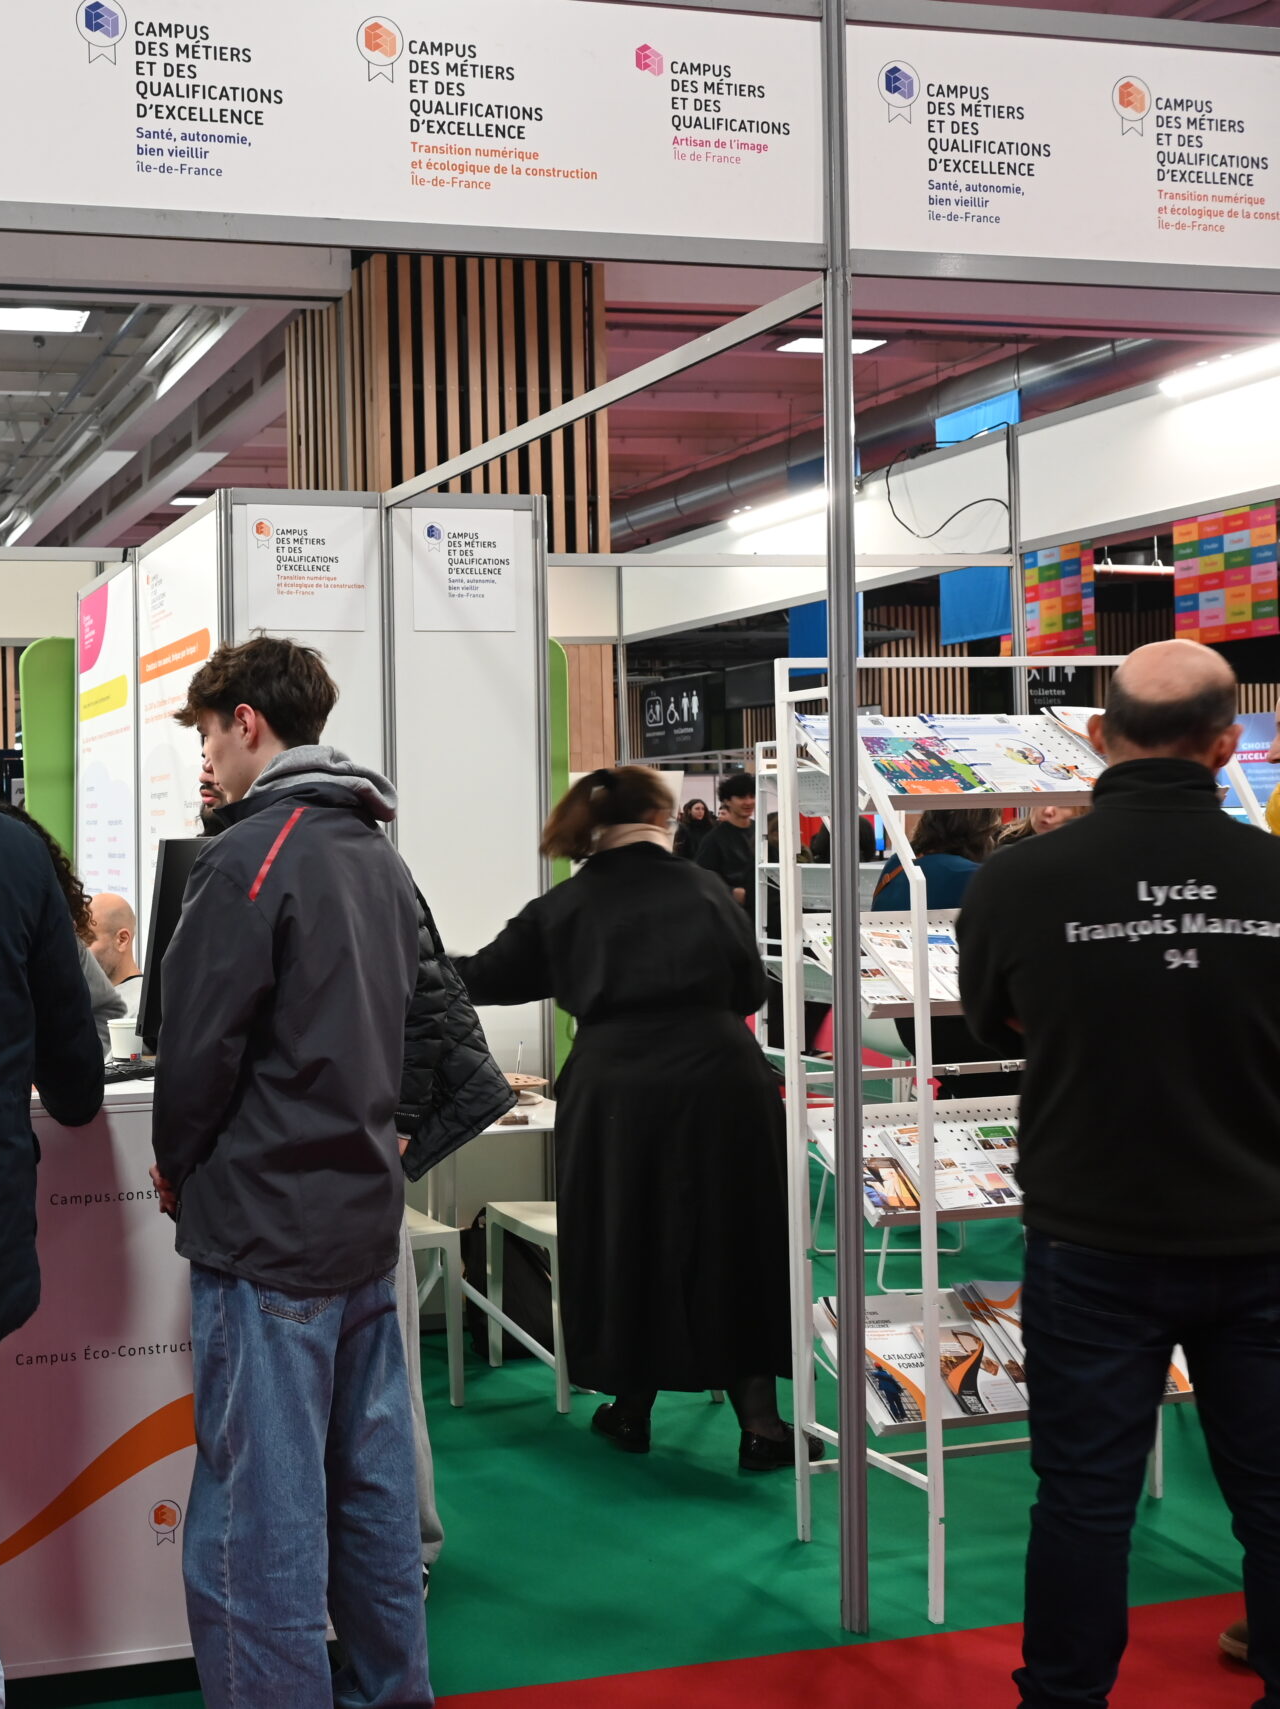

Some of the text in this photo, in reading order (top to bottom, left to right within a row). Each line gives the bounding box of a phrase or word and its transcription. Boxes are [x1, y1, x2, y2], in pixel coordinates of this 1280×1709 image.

[135, 21, 209, 40] CAMPUS
[135, 40, 251, 63] DES MÉTIERS
[409, 40, 476, 58] CAMPUS
[136, 61, 196, 79] ET DES
[409, 59, 514, 80] DES MÉTIERS
[671, 61, 731, 78] CAMPUS
[136, 81, 283, 104] QUALIFICATIONS
[410, 79, 465, 96] ET DES
[671, 79, 765, 98] DES MÉTIERS
[927, 84, 989, 101] CAMPUS
[410, 99, 543, 121] QUALIFICATIONS
[672, 97, 720, 112] ET DES
[928, 101, 1024, 120] DES MÉTIERS
[1156, 97, 1212, 113] CAMPUS
[137, 103, 264, 125] D'EXCELLENCE
[410, 119, 525, 140] D'EXCELLENCE
[672, 115, 790, 135] QUALIFICATIONS
[928, 120, 978, 135] ET DES
[1156, 114, 1244, 133] DES MÉTIERS
[136, 127, 251, 147] Santé, autonomie,
[672, 136, 768, 154] Artisan de l'image
[1157, 133, 1203, 148] ET DES
[137, 144, 209, 159] bien vieillir
[410, 142, 539, 162] Transition numérique
[928, 138, 1050, 157] QUALIFICATIONS
[674, 150, 741, 164] Île de France
[1157, 151, 1268, 170] QUALIFICATIONS
[136, 160, 222, 176] île-de-France
[411, 159, 597, 180] et écologique de la construction
[929, 158, 1034, 176] D'EXCELLENCE
[411, 171, 491, 190] Île-de-France
[1157, 169, 1254, 186] D'EXCELLENCE
[928, 180, 1024, 196] Santé, autonomie,
[929, 195, 989, 208] bien vieillir
[1158, 190, 1265, 206] Transition numérique
[928, 210, 1000, 223] île-de-France
[1158, 206, 1167, 214] et
[1170, 204, 1224, 219] écologique
[1227, 208, 1239, 218] de
[1242, 209, 1250, 219] la
[1157, 216, 1225, 232] Île-de-France
[293, 536, 325, 545] MÉTIERS
[465, 539, 496, 548] MÉTIERS
[276, 555, 338, 563] QUALIFICATIONS
[448, 558, 510, 566] QUALIFICATIONS
[277, 564, 331, 572] D'EXCELLENCE
[1029, 688, 1066, 696] toilettes
[1137, 878, 1218, 907] Lycée
[1065, 914, 1177, 943] François
[1164, 948, 1200, 969] 94
[15, 1350, 77, 1366] Campus
